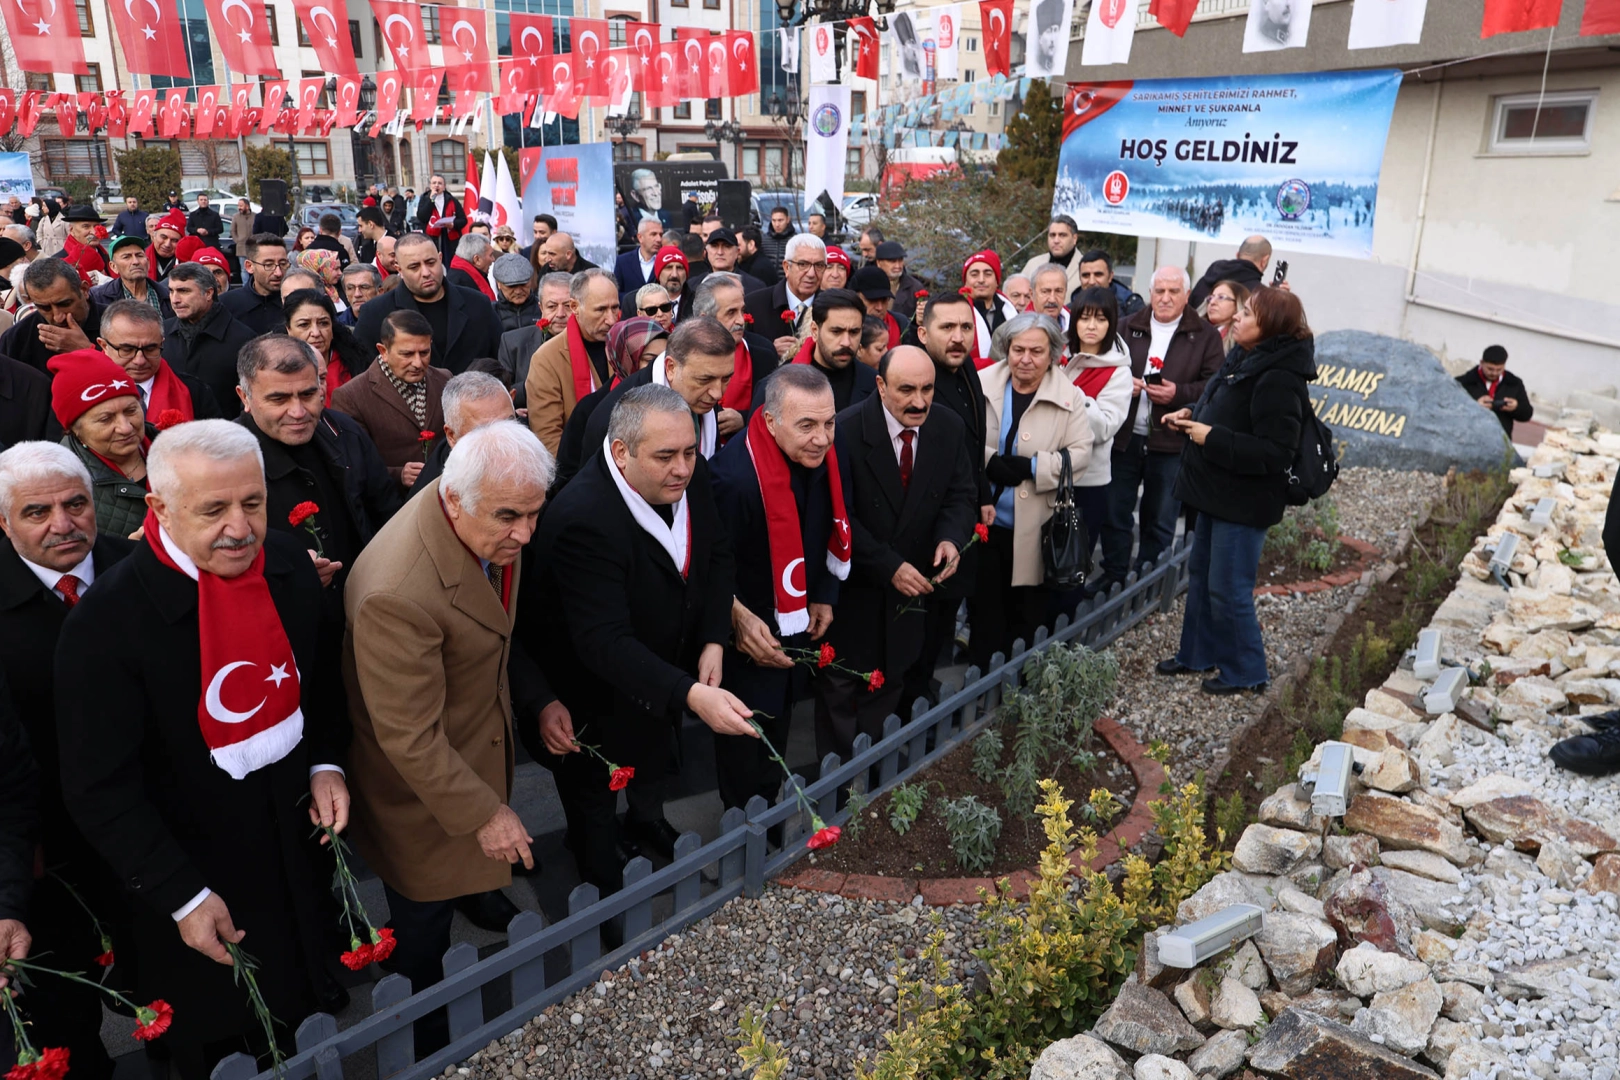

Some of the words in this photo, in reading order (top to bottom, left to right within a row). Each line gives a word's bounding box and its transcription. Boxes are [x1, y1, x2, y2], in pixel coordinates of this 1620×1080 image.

[1157, 103, 1191, 113] MİNNET
[1194, 104, 1206, 113] VE
[1251, 88, 1298, 100] RAHMET,
[1119, 138, 1168, 167] HOŞ
[1174, 132, 1299, 165] GELDİNİZ
[1306, 364, 1385, 401] IKAMIŞ
[1321, 402, 1407, 438] ANISINA
